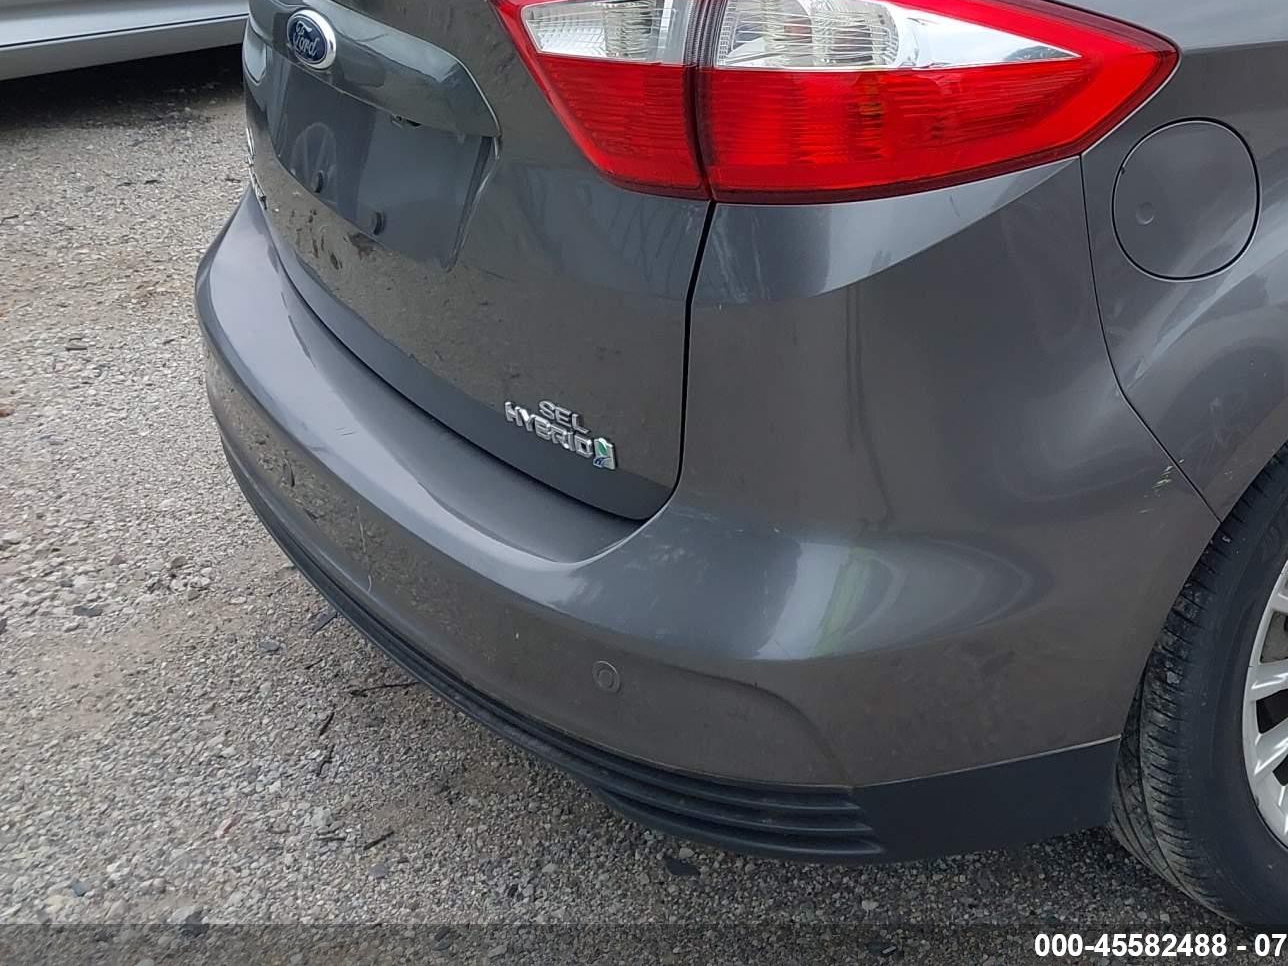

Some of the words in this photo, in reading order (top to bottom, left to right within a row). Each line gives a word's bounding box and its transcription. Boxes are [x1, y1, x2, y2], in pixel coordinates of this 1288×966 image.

[292, 20, 320, 56] Ford
[504, 401, 593, 459] HYBRID
[538, 400, 592, 434] SEL
